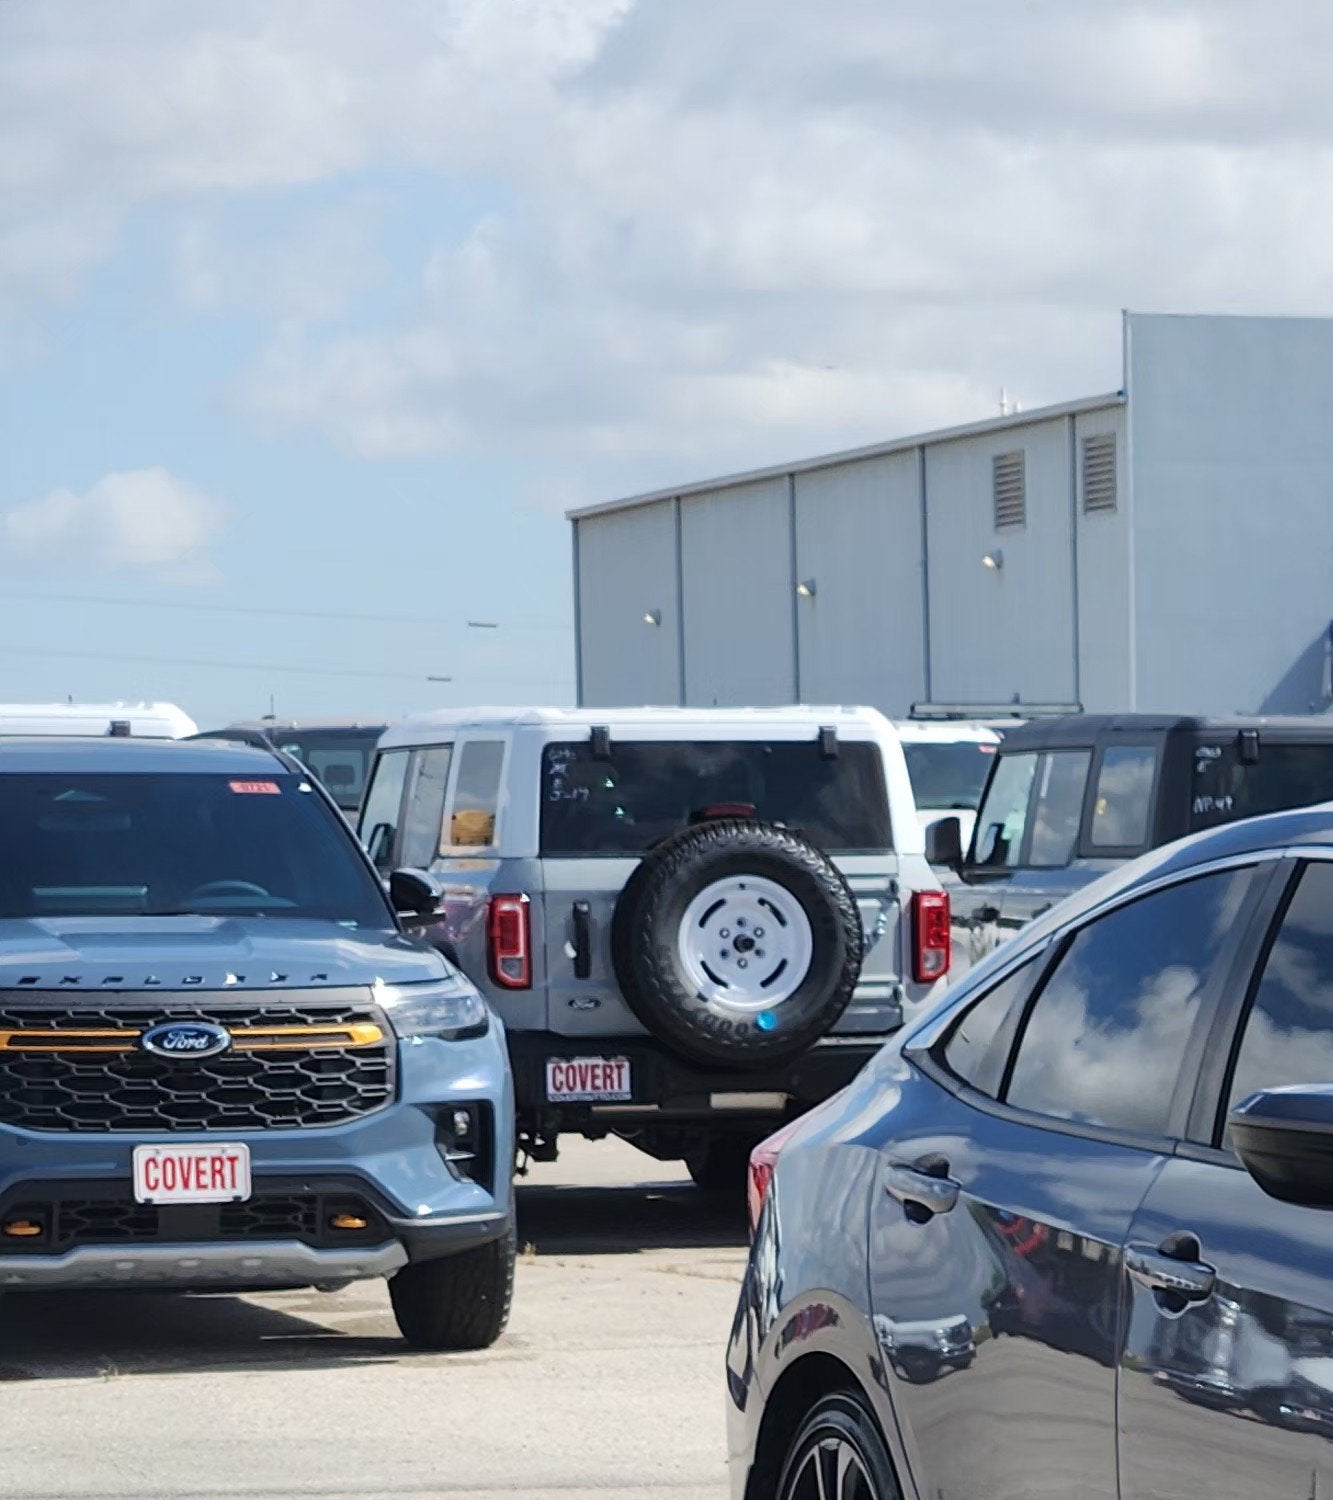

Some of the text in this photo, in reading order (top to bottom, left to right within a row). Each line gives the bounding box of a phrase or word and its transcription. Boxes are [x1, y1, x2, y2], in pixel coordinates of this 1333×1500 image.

[163, 1030, 210, 1050] Ford
[552, 1063, 625, 1093] COVERT
[144, 1155, 239, 1192] COVERT
